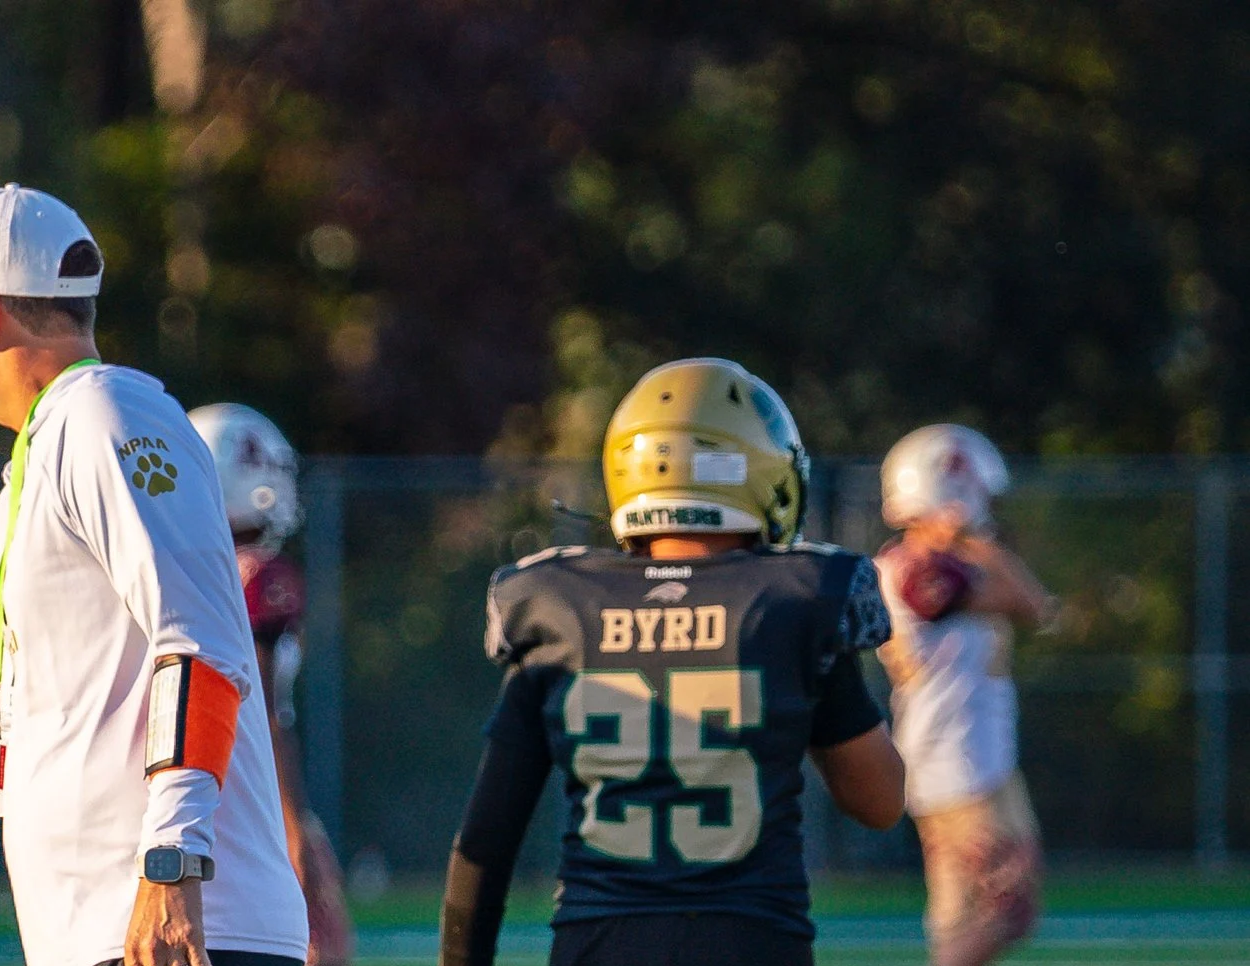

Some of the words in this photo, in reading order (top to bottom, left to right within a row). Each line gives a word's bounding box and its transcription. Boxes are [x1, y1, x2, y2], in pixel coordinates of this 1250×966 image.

[118, 436, 170, 461] NPAA
[599, 605, 727, 652] BYRD
[563, 665, 764, 863] 25
